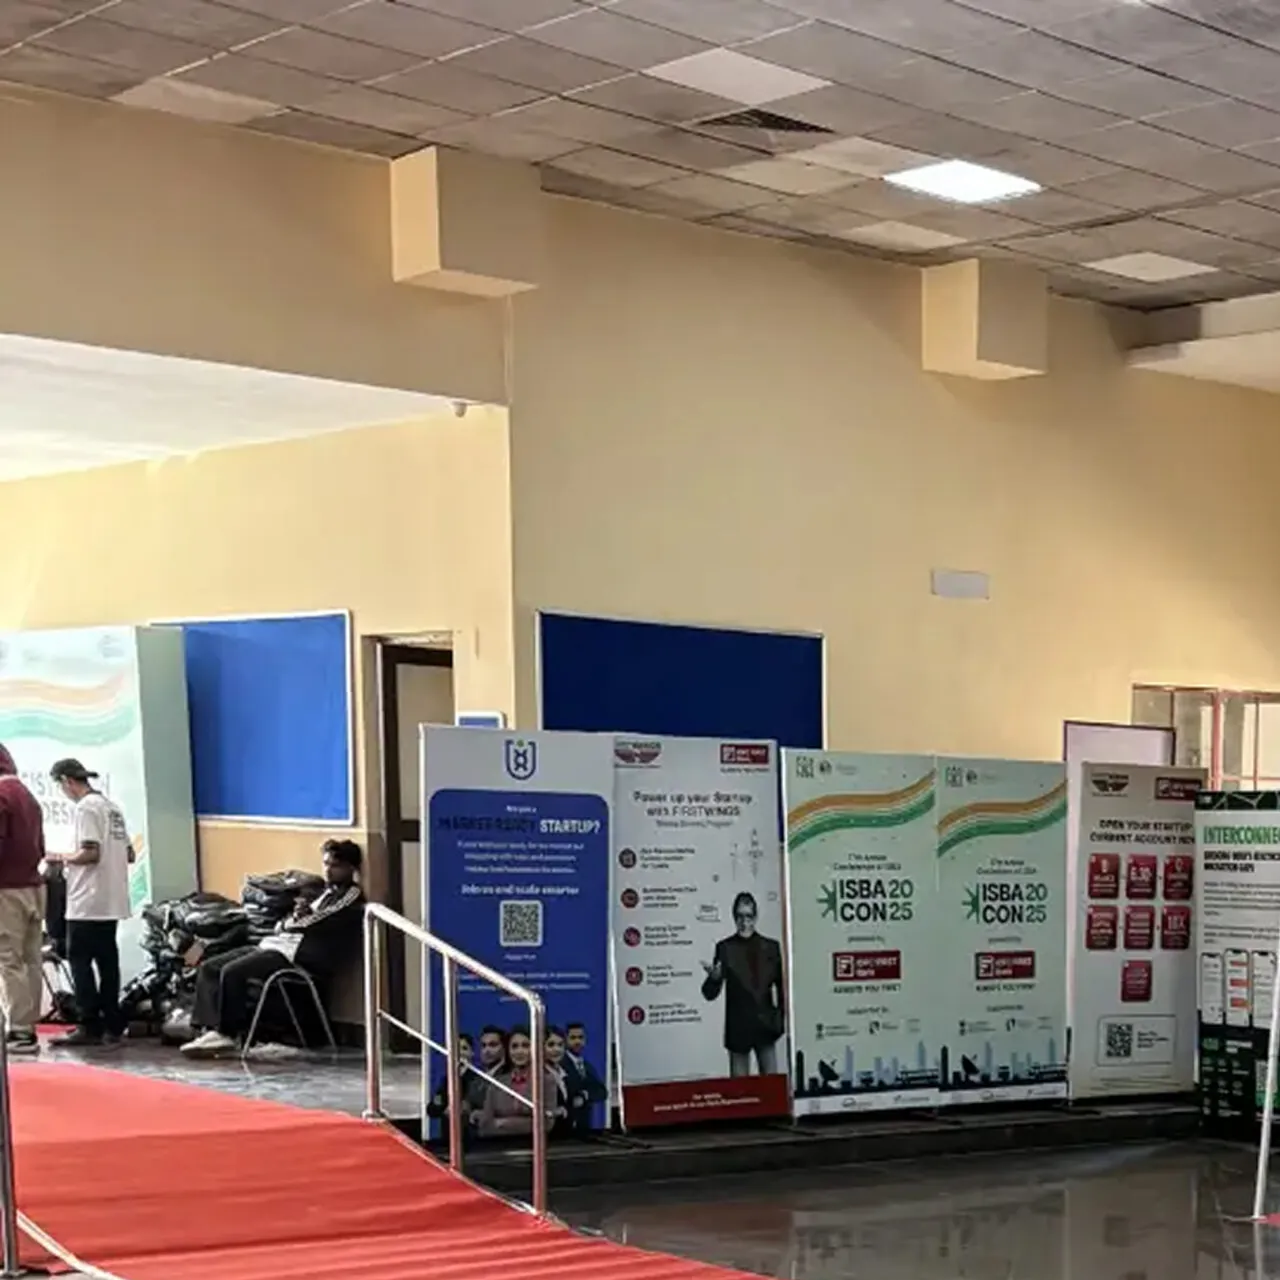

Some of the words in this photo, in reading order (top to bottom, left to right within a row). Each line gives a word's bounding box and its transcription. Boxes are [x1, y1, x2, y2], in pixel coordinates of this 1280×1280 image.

[539, 819, 601, 834] STARTUP?
[838, 879, 888, 900] ISBA
[888, 878, 915, 900] 20
[982, 882, 1024, 903] ISBA
[1025, 882, 1049, 902] 20
[839, 901, 888, 923] CON
[888, 901, 914, 922] 25
[982, 904, 1024, 924] CON
[1025, 904, 1048, 924] 25
